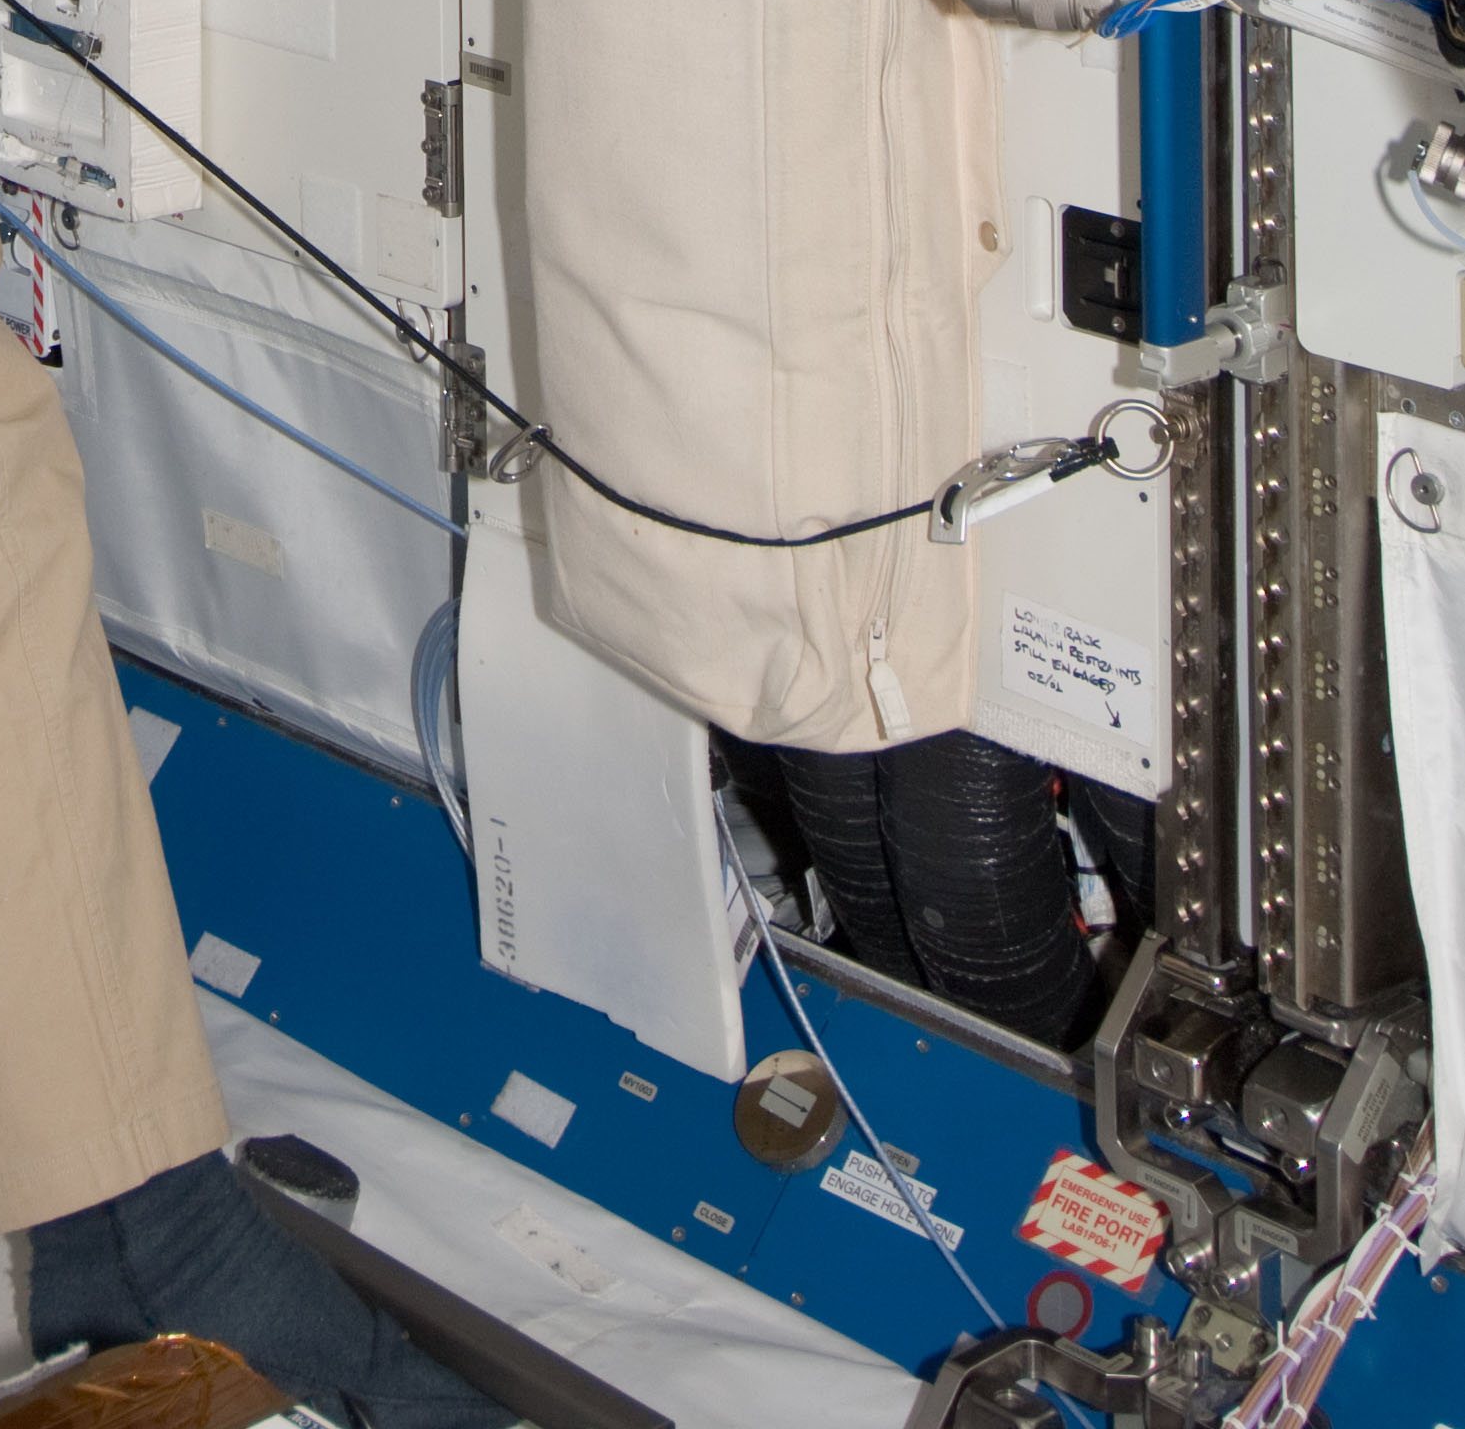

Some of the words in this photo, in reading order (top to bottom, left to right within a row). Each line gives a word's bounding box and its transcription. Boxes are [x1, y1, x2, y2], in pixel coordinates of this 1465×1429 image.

[5, 317, 31, 336] POWER
[1014, 640, 1047, 663] STILL
[1051, 658, 1116, 696] ENGAGED
[621, 1073, 654, 1098] MV1003
[847, 1155, 884, 1183] PUSH
[916, 1188, 934, 1207] TO
[885, 1149, 911, 1169] OPEN
[698, 1206, 729, 1229] CLOSE
[826, 1173, 880, 1209] ENGAGE
[879, 1198, 915, 1225] HOLE
[1050, 1192, 1096, 1231] FIRE
[1093, 1212, 1144, 1248] PORT
[1060, 1177, 1127, 1218] EMERGENCY
[1127, 1209, 1152, 1229] USE
